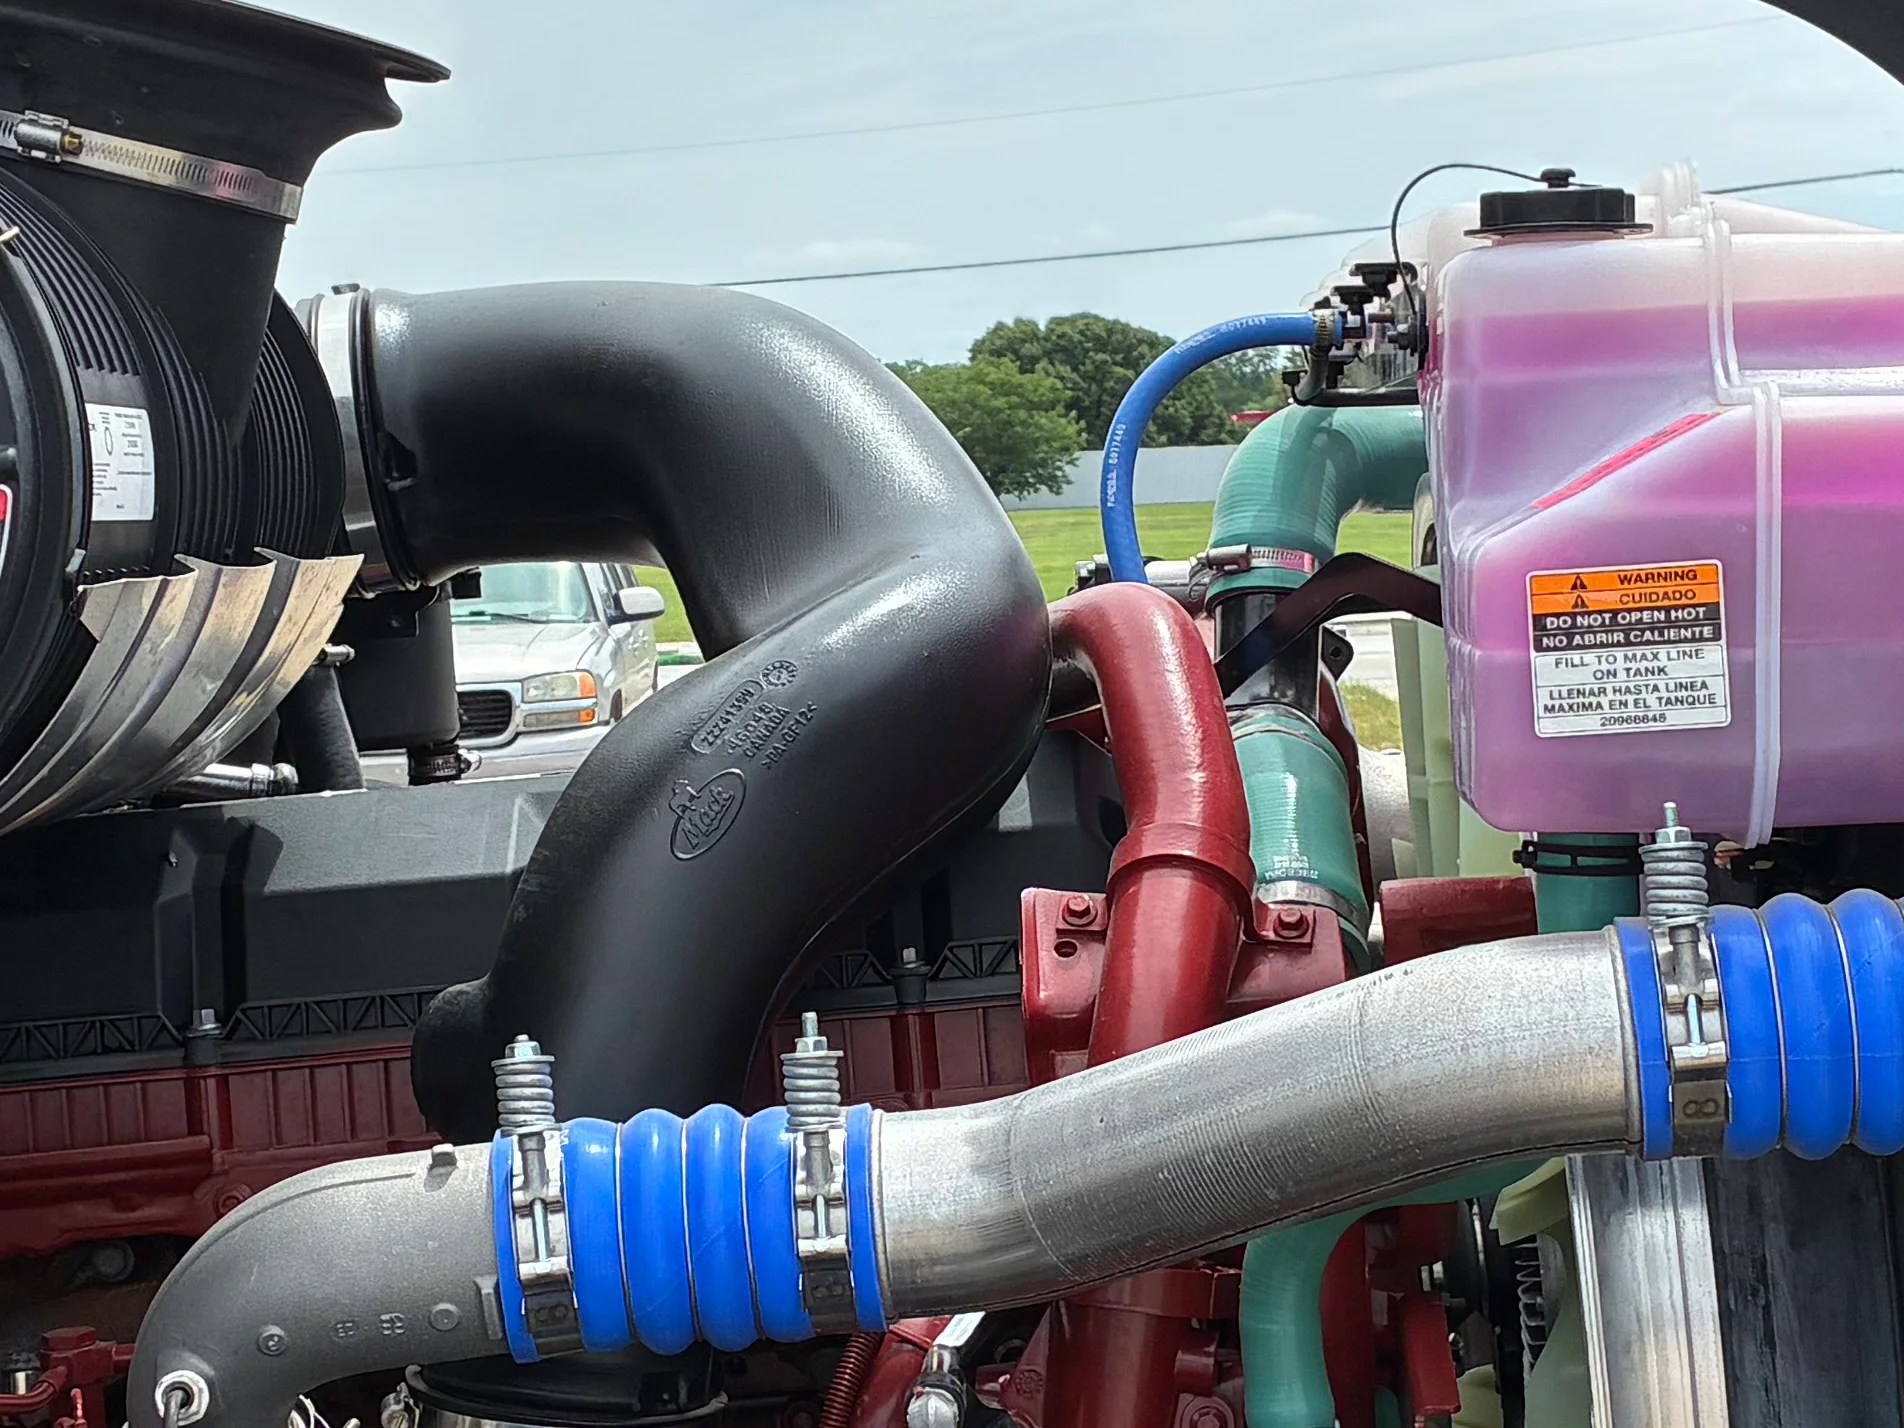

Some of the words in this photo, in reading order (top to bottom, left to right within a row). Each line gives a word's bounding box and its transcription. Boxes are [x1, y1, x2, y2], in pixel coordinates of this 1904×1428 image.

[1618, 569, 1697, 585] WARNING
[1619, 589, 1696, 605] CUIDADO
[1546, 616, 1572, 629] DO
[1576, 613, 1612, 626] NOT
[1617, 610, 1665, 624] OPEN
[1670, 607, 1706, 621] HOT
[1542, 636, 1567, 647] NO
[1572, 632, 1625, 646] ABRIR
[1630, 626, 1713, 642] CALIENTE
[1555, 656, 1590, 669] FILL
[1594, 654, 1617, 666] TO
[1623, 651, 1661, 664] MAX
[1666, 648, 1705, 661] LINE
[1593, 668, 1617, 681] ON
[1623, 665, 1668, 678] TANK
[1549, 686, 1608, 700] LLENAR
[1612, 683, 1661, 696] HASTA
[1665, 680, 1709, 693] LINEA
[1543, 701, 1604, 714] MAXIMA
[1608, 699, 1628, 710] EN
[1633, 698, 1651, 709] EL
[1655, 693, 1717, 707] TANQUE
[682, 785, 732, 849] Mack
